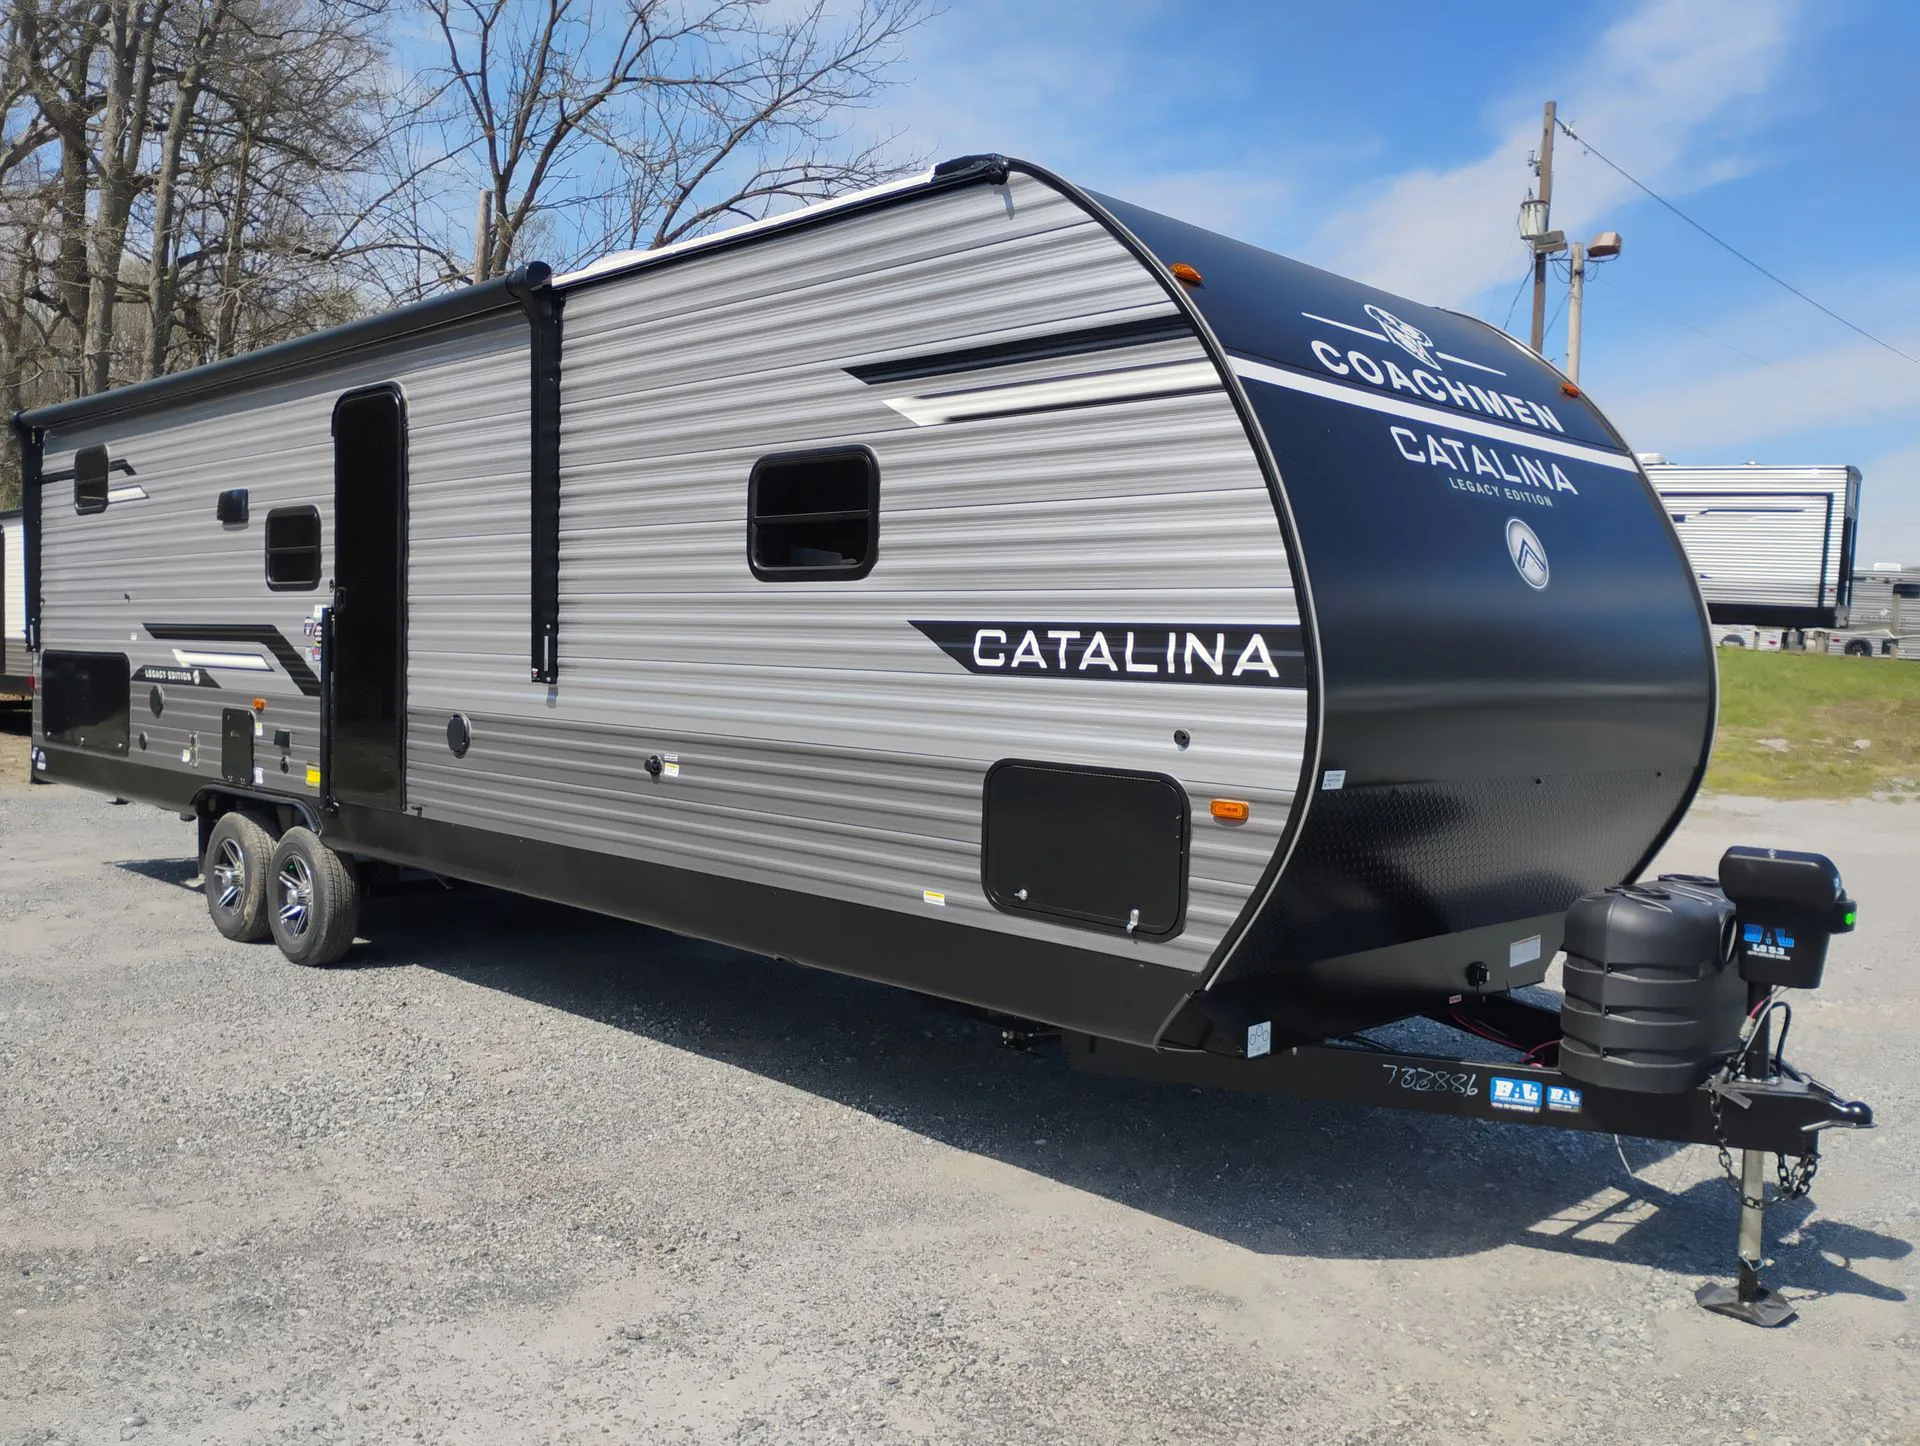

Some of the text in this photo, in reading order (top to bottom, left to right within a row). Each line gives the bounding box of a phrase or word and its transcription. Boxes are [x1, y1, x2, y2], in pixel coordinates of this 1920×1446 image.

[1310, 339, 1565, 433] COACHMEN
[1389, 425, 1580, 496] CATALINA
[1448, 476, 1553, 508] LEGACY EDITION
[972, 628, 1280, 678] CATALINA
[145, 669, 191, 681] LEGACY EDITION
[1495, 1080, 1538, 1100] BAL
[1550, 1088, 1580, 1102] BAL
